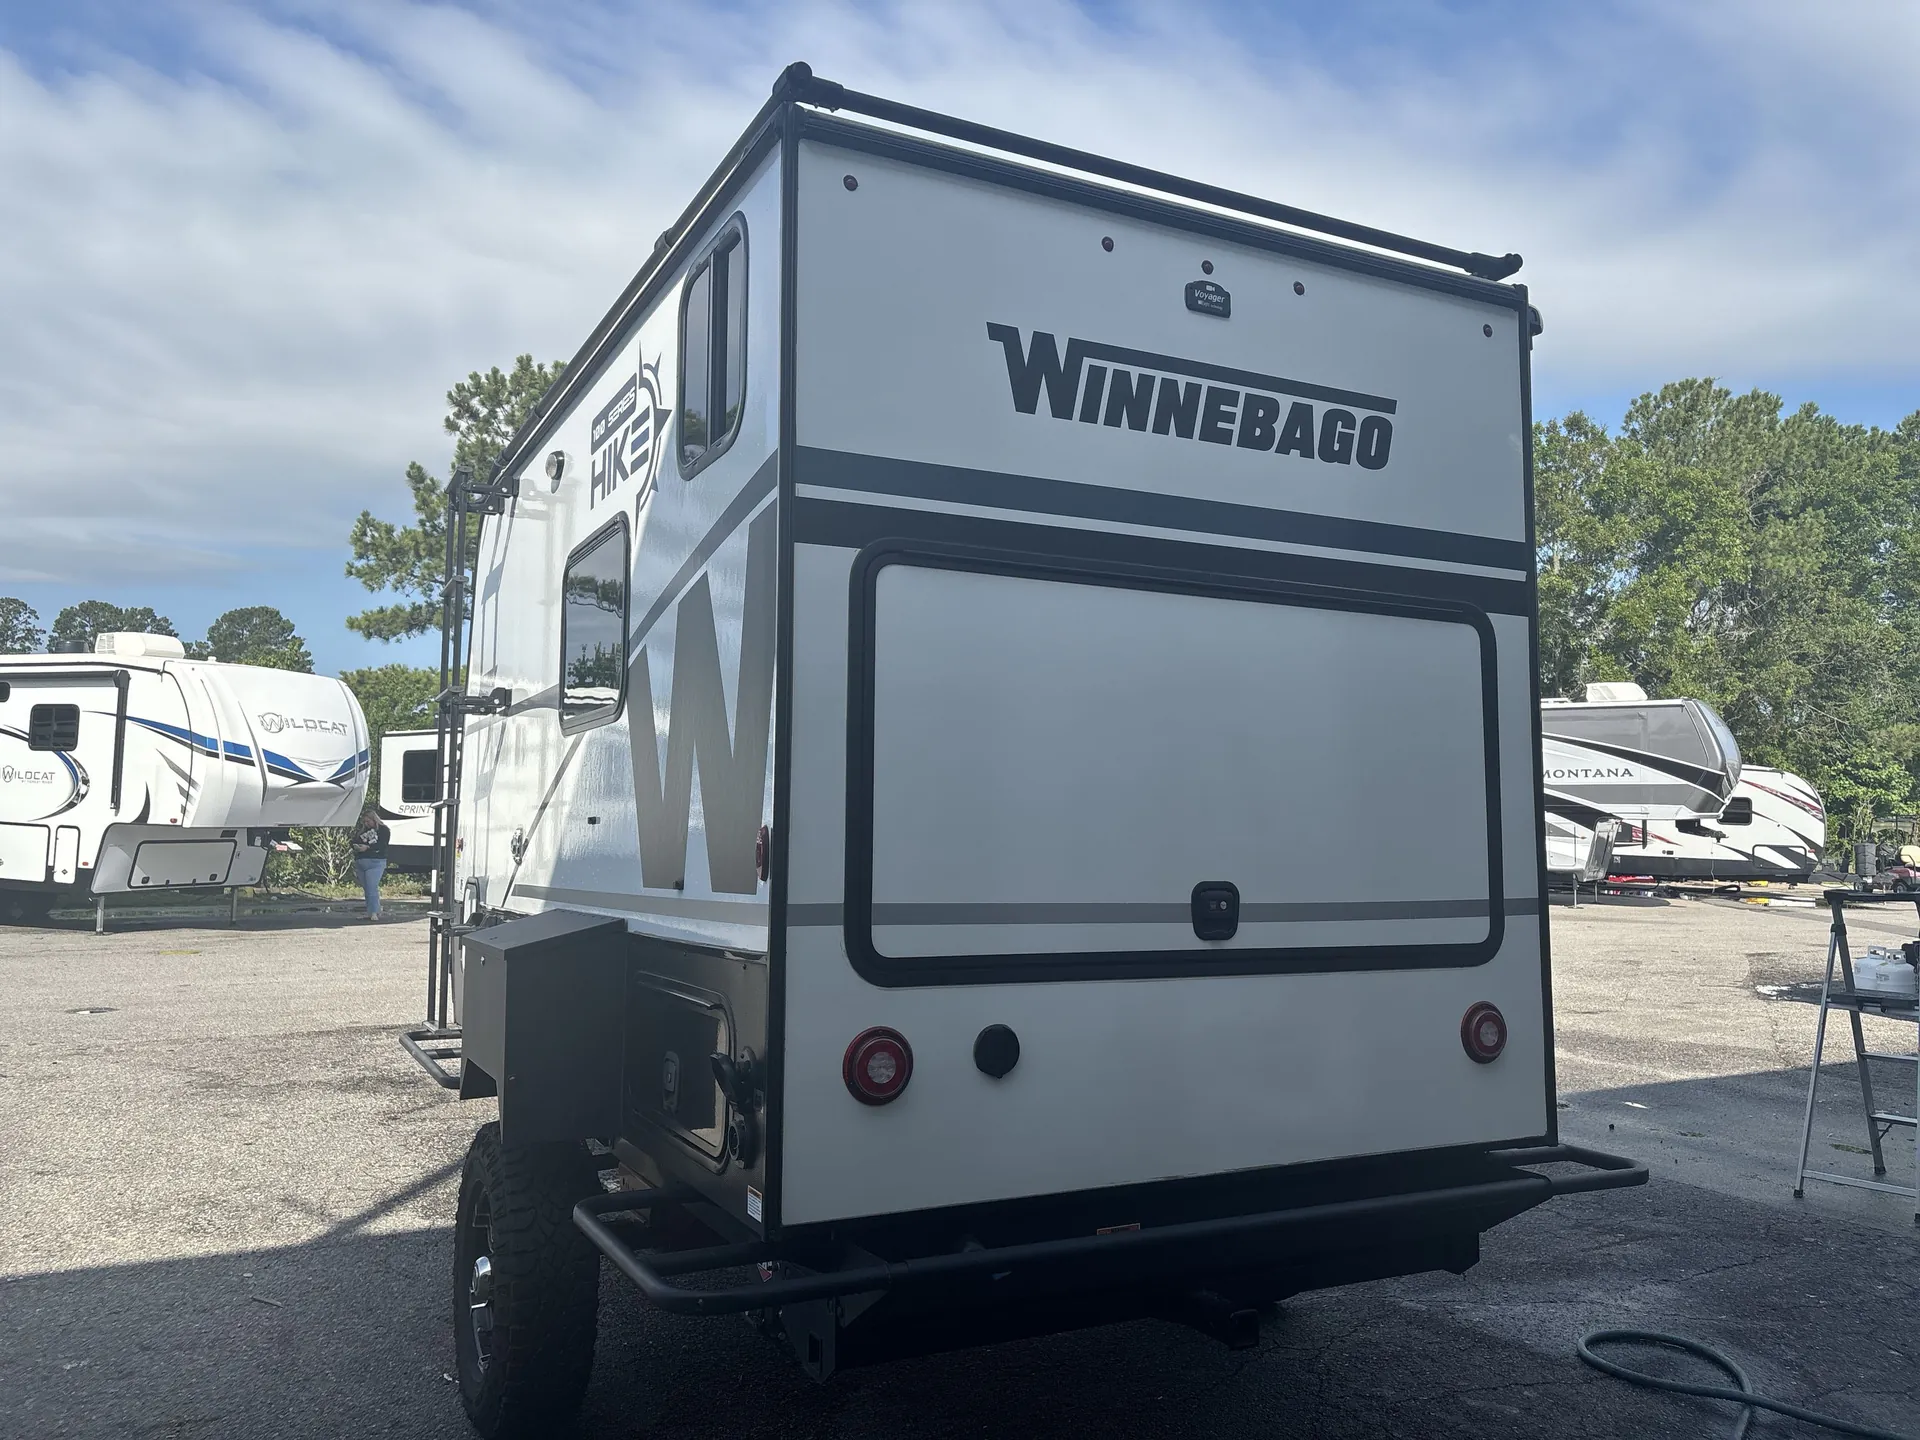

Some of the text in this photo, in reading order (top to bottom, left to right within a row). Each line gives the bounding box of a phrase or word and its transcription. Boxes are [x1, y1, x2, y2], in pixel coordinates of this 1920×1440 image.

[1194, 289, 1225, 303] Voyager
[986, 321, 1398, 471] WINNEBAGO
[593, 385, 636, 443] 100 SERIES
[590, 404, 650, 511] HIKE
[257, 711, 348, 735] WILDCAT
[2, 765, 56, 783] WILDCAT
[398, 804, 435, 814] SPRINT
